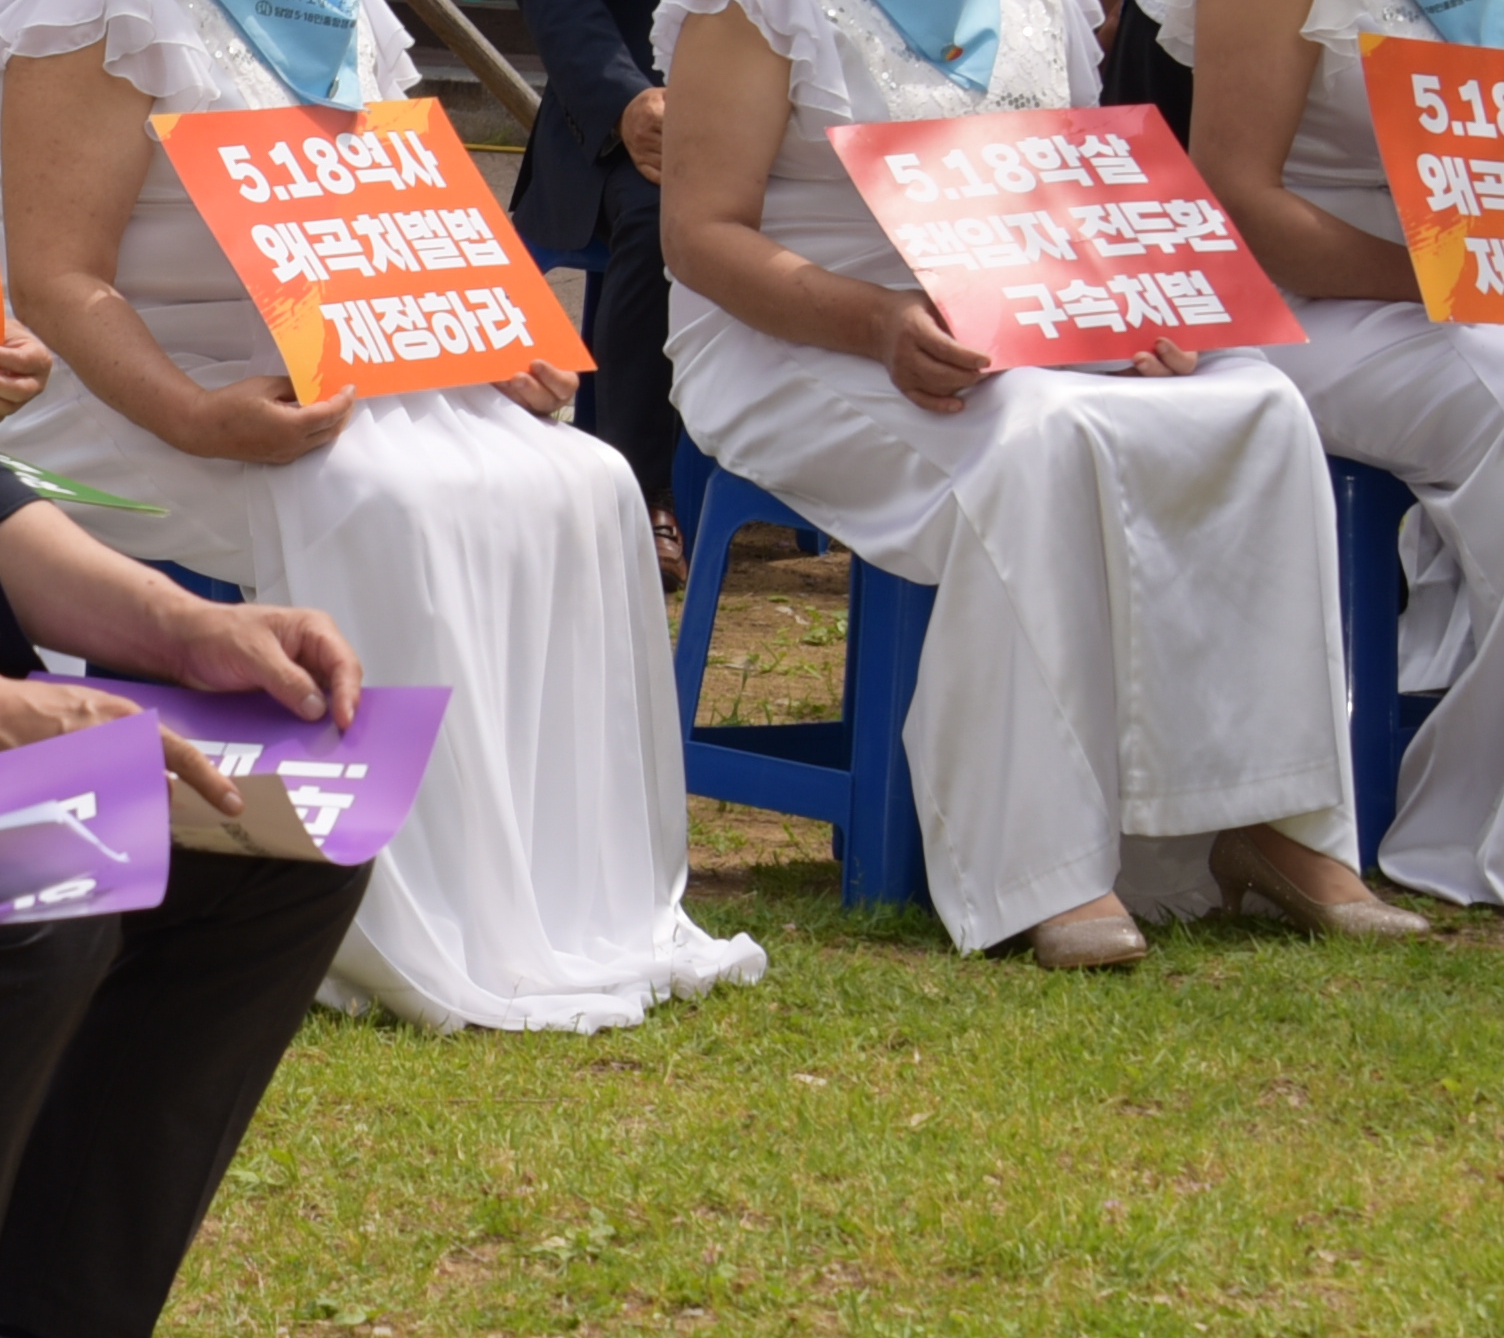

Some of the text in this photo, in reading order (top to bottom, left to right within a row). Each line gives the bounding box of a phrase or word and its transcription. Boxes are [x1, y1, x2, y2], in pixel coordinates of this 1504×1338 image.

[219, 131, 445, 203] 5.18역사
[887, 131, 1151, 203] 5.18학살
[251, 206, 511, 284] 왜곡처벌법
[897, 199, 1238, 271] 책임자 전두환
[323, 288, 531, 366] 제정하라
[1004, 270, 1233, 337] 구속처벌
